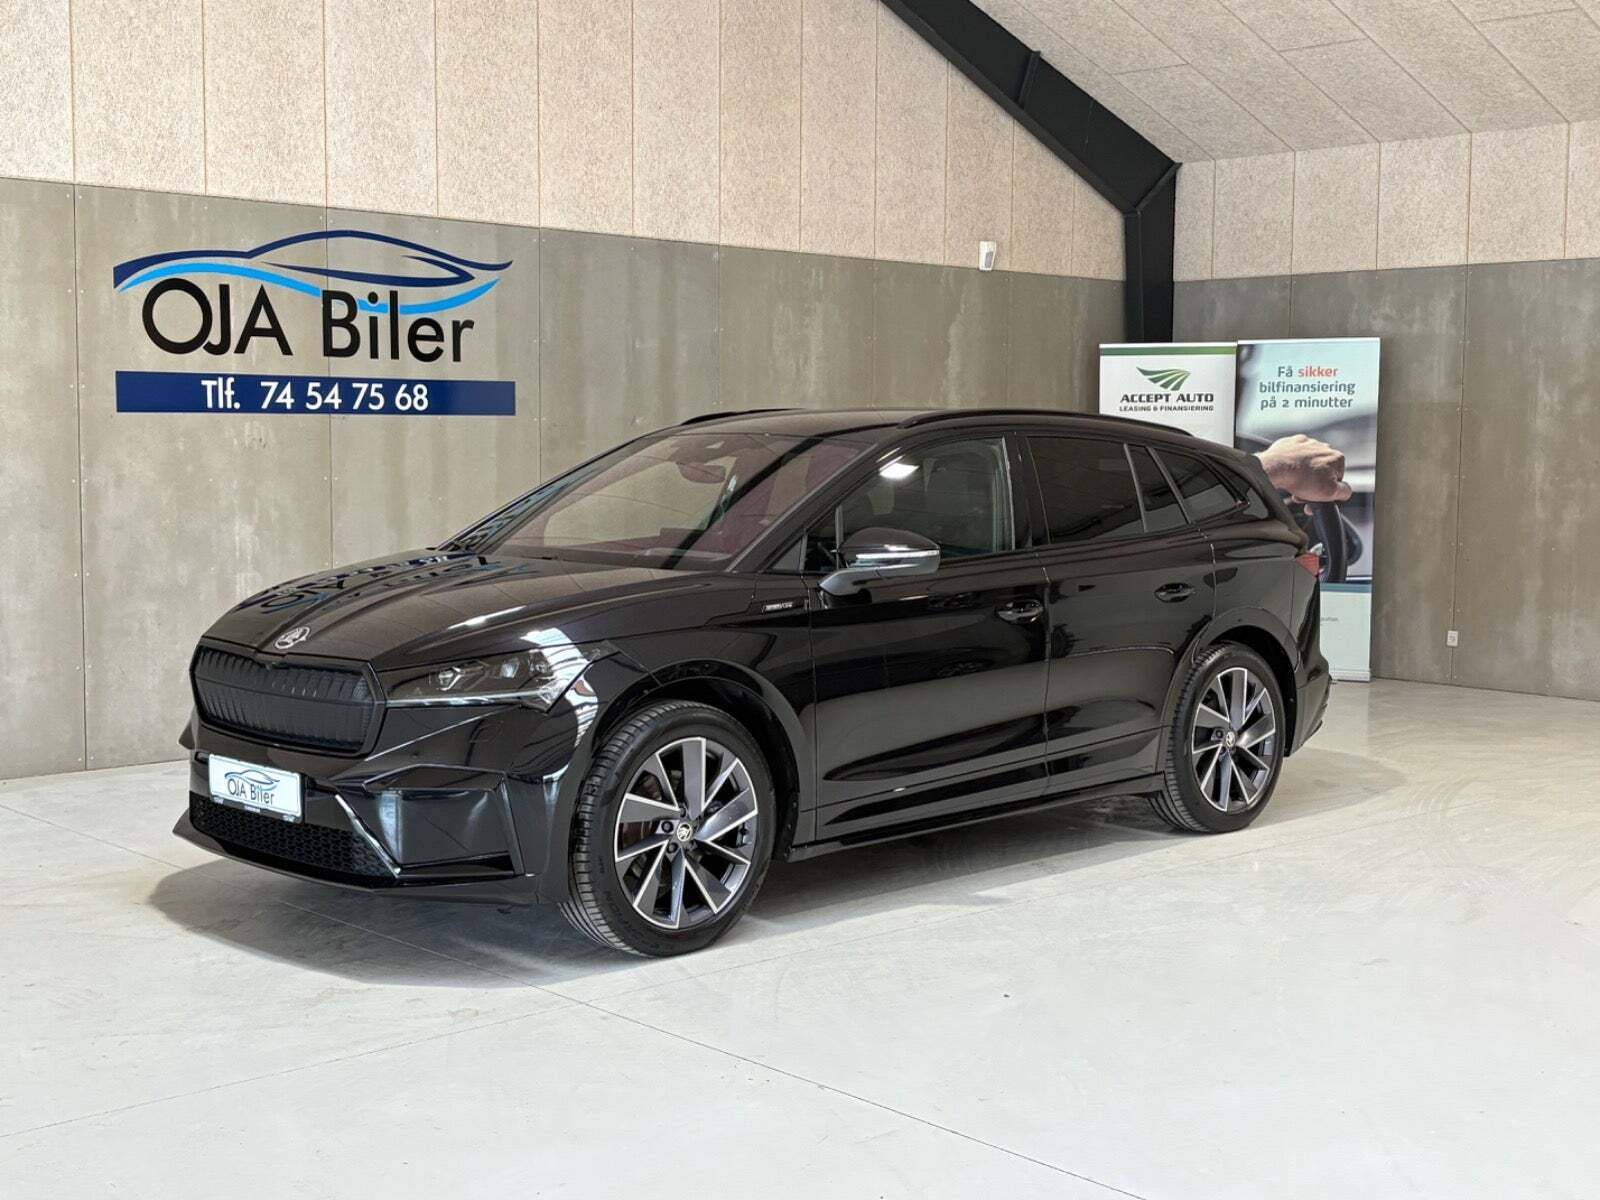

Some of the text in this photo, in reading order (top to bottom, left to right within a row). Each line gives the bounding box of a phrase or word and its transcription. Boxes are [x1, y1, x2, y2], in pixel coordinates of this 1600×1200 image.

[142, 277, 475, 363] OJA Biler
[1277, 365, 1339, 378] Få sikker
[201, 377, 429, 411] Tlf. 74 54 75 68
[1259, 381, 1356, 395] bilfinansiering
[1120, 393, 1214, 403] ACCEPT AUTO
[1260, 396, 1354, 411] på 2 minutter
[228, 779, 275, 805] OJA Biler
